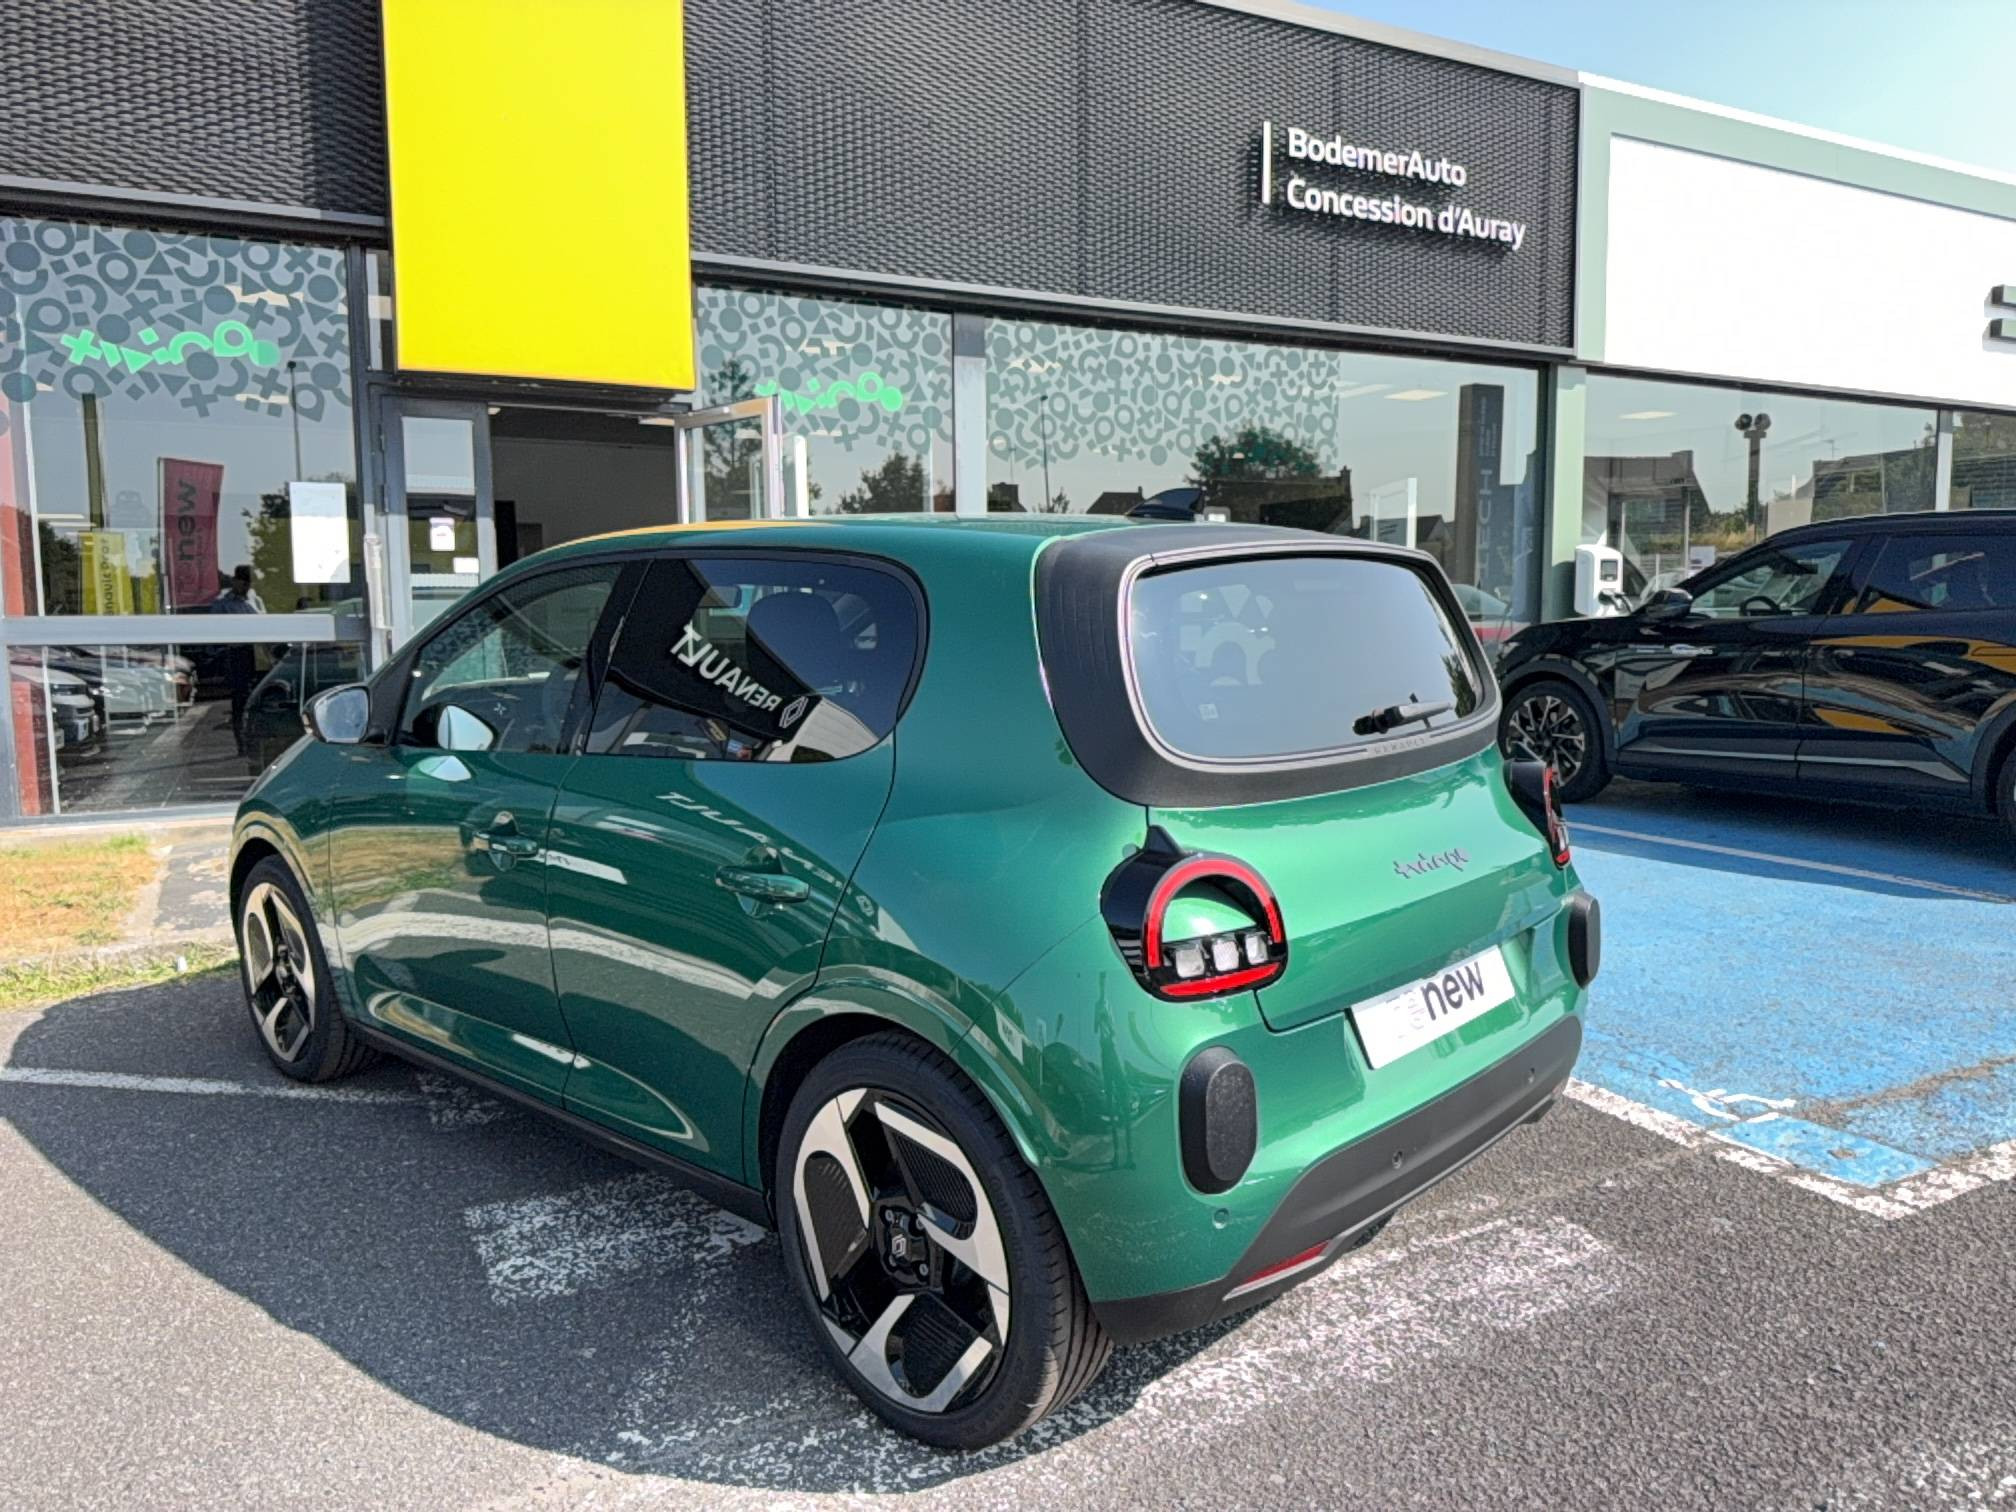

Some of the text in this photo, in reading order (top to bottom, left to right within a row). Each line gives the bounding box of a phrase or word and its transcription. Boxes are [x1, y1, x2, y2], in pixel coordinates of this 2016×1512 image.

[1287, 127, 1467, 187] BodemerAuto
[1286, 178, 1526, 250] Concession d'Auray
